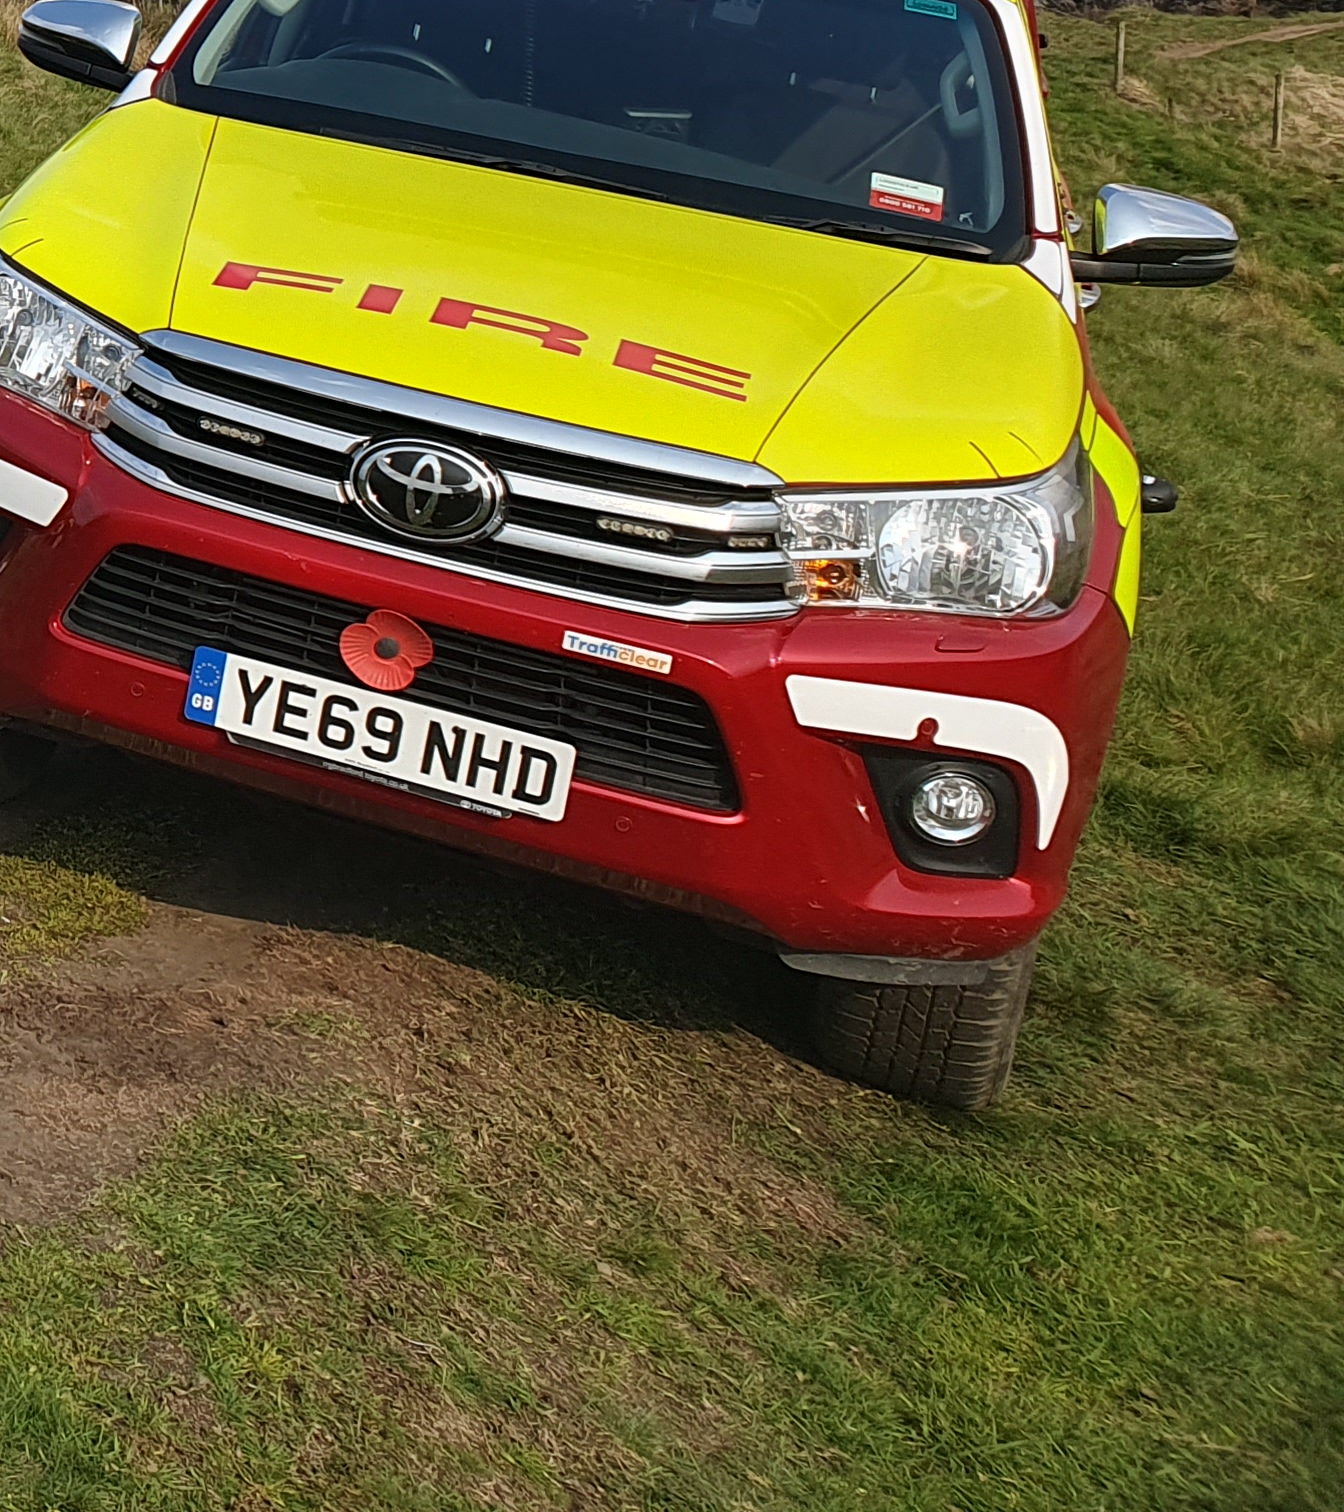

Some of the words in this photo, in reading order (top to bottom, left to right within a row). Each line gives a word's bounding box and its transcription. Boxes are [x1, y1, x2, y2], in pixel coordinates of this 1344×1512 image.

[212, 261, 752, 402] FIRE
[191, 692, 214, 712] GB
[238, 669, 404, 764] YE69
[420, 720, 558, 806] NHD
[472, 803, 503, 817] TOYOTA
